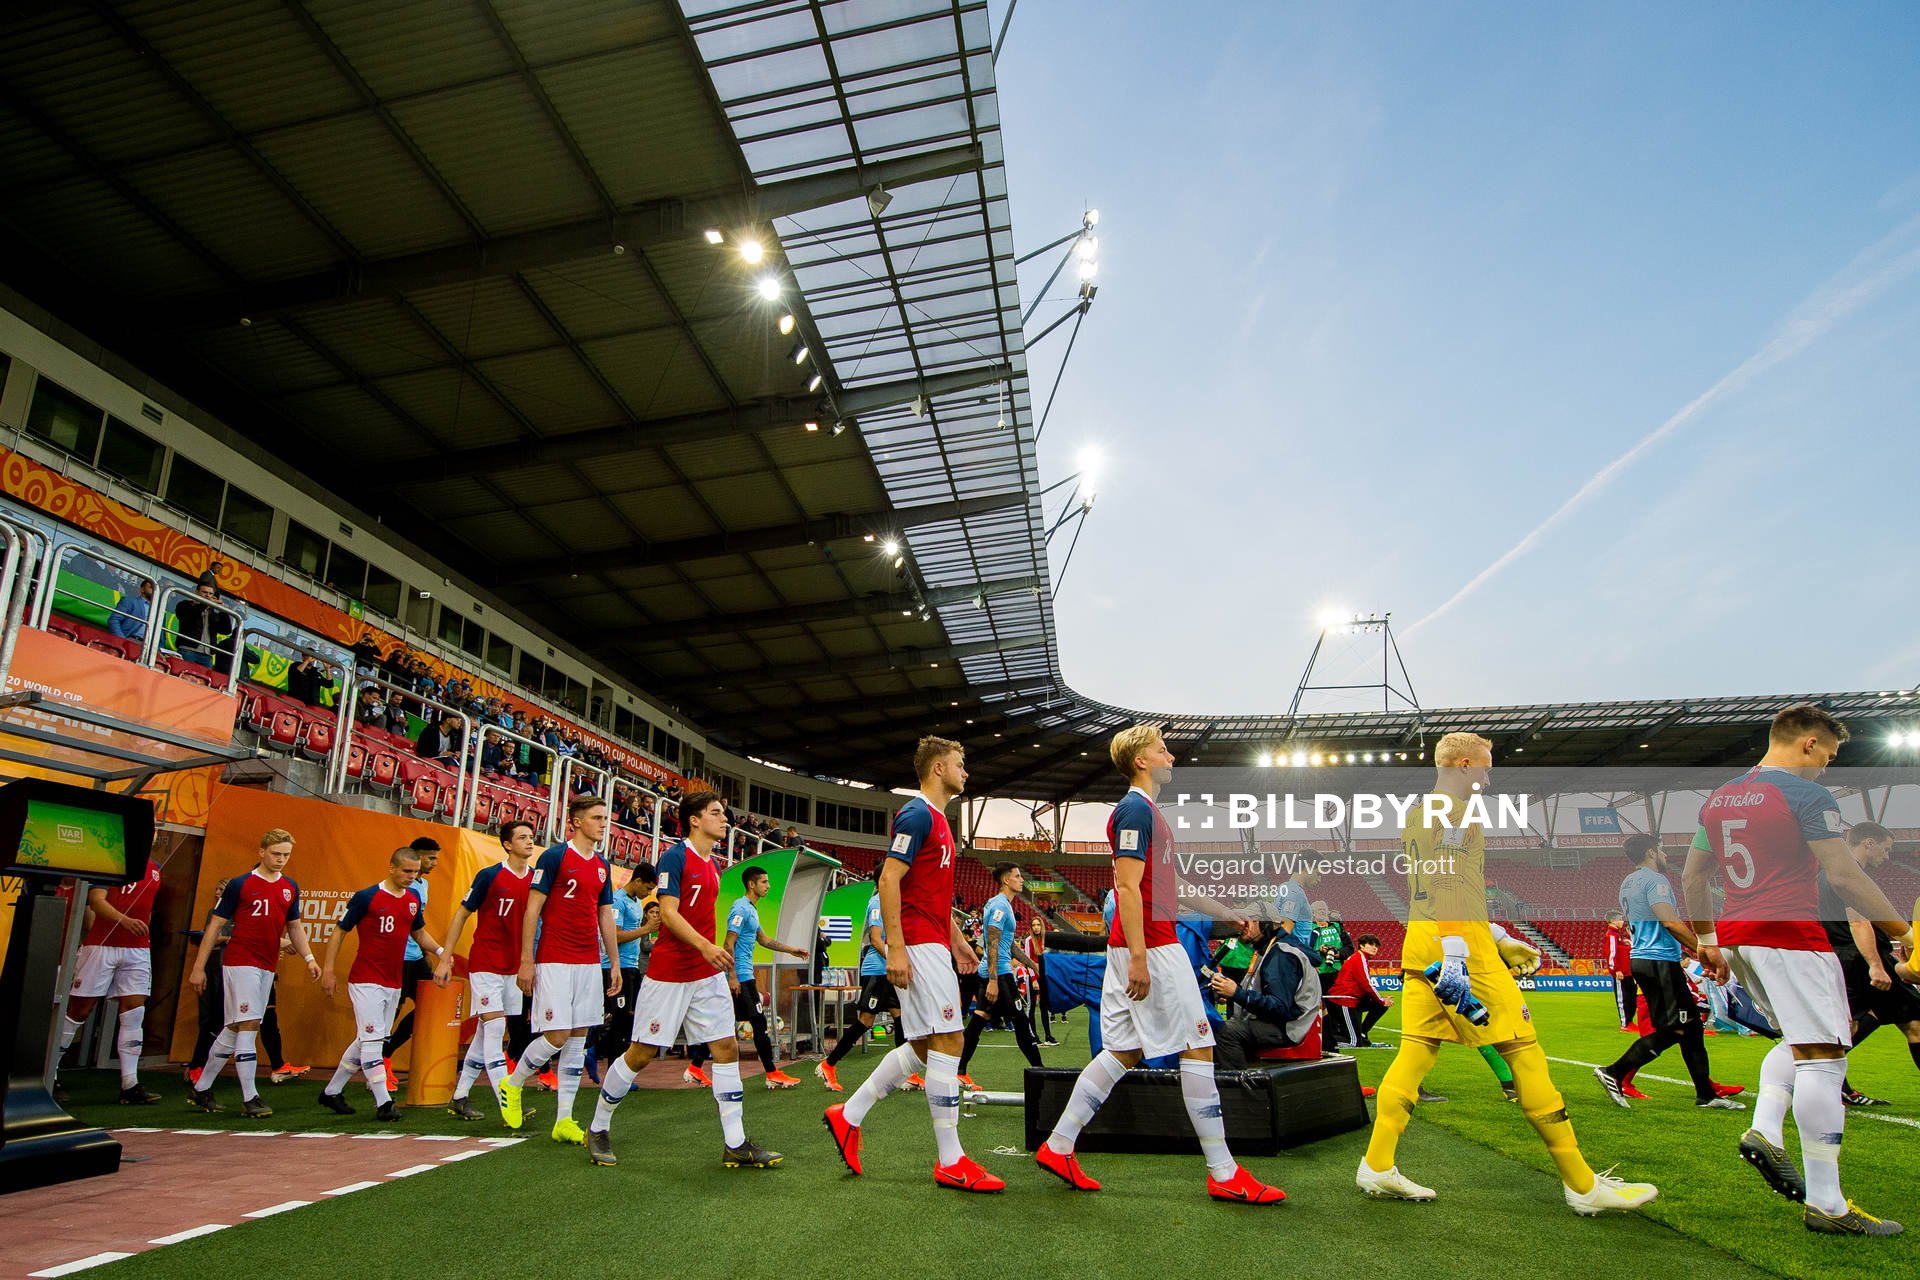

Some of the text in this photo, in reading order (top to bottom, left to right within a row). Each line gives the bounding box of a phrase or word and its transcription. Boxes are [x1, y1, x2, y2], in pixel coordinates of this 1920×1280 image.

[23, 679, 62, 697] WORLD
[63, 691, 83, 702] CUP
[583, 733, 611, 755] WORLD
[611, 748, 626, 762] CUP
[626, 755, 653, 776] POLAND
[1584, 815, 1614, 825] FIFA
[60, 826, 82, 839] VAR
[1503, 838, 1538, 848] WORLD
[1560, 836, 1578, 846] CUP
[1580, 836, 1620, 845] POLAND
[940, 845, 951, 869] 14
[1721, 819, 1756, 889] 5
[310, 889, 339, 898] WORLD
[562, 878, 578, 899] 2
[689, 885, 702, 907] 7
[251, 899, 269, 917] 21
[299, 899, 349, 920] OLA
[498, 898, 515, 917] 17
[378, 915, 395, 933] 18
[1381, 978, 1402, 987] FOU
[1536, 980, 1613, 988] LIVING FOOTB
